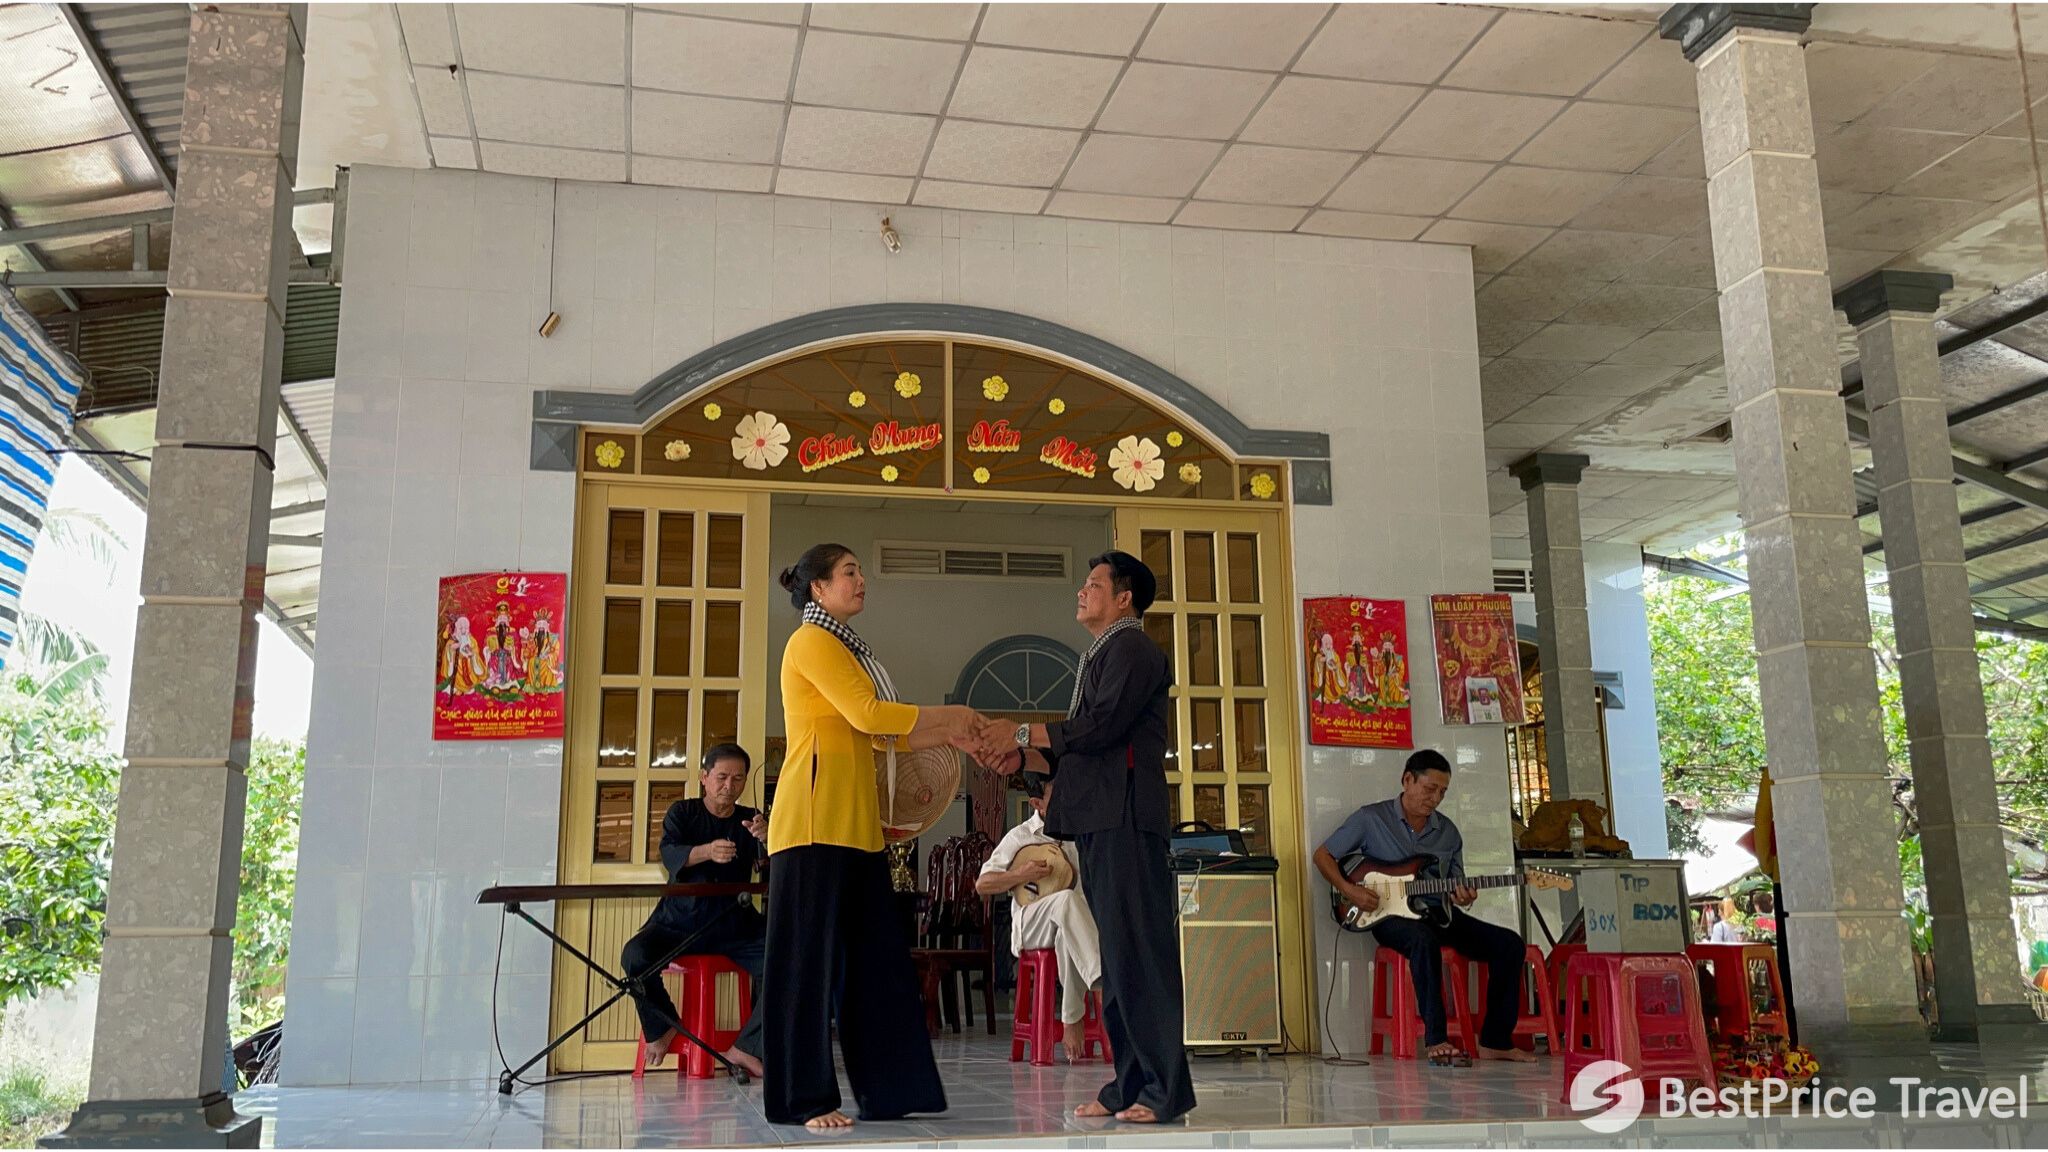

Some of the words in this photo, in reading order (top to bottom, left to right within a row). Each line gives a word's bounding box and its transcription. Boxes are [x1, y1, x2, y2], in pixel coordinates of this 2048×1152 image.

[1434, 601, 1450, 611] KIM
[1620, 873, 1650, 892] TIP
[1633, 903, 1679, 921] BOX
